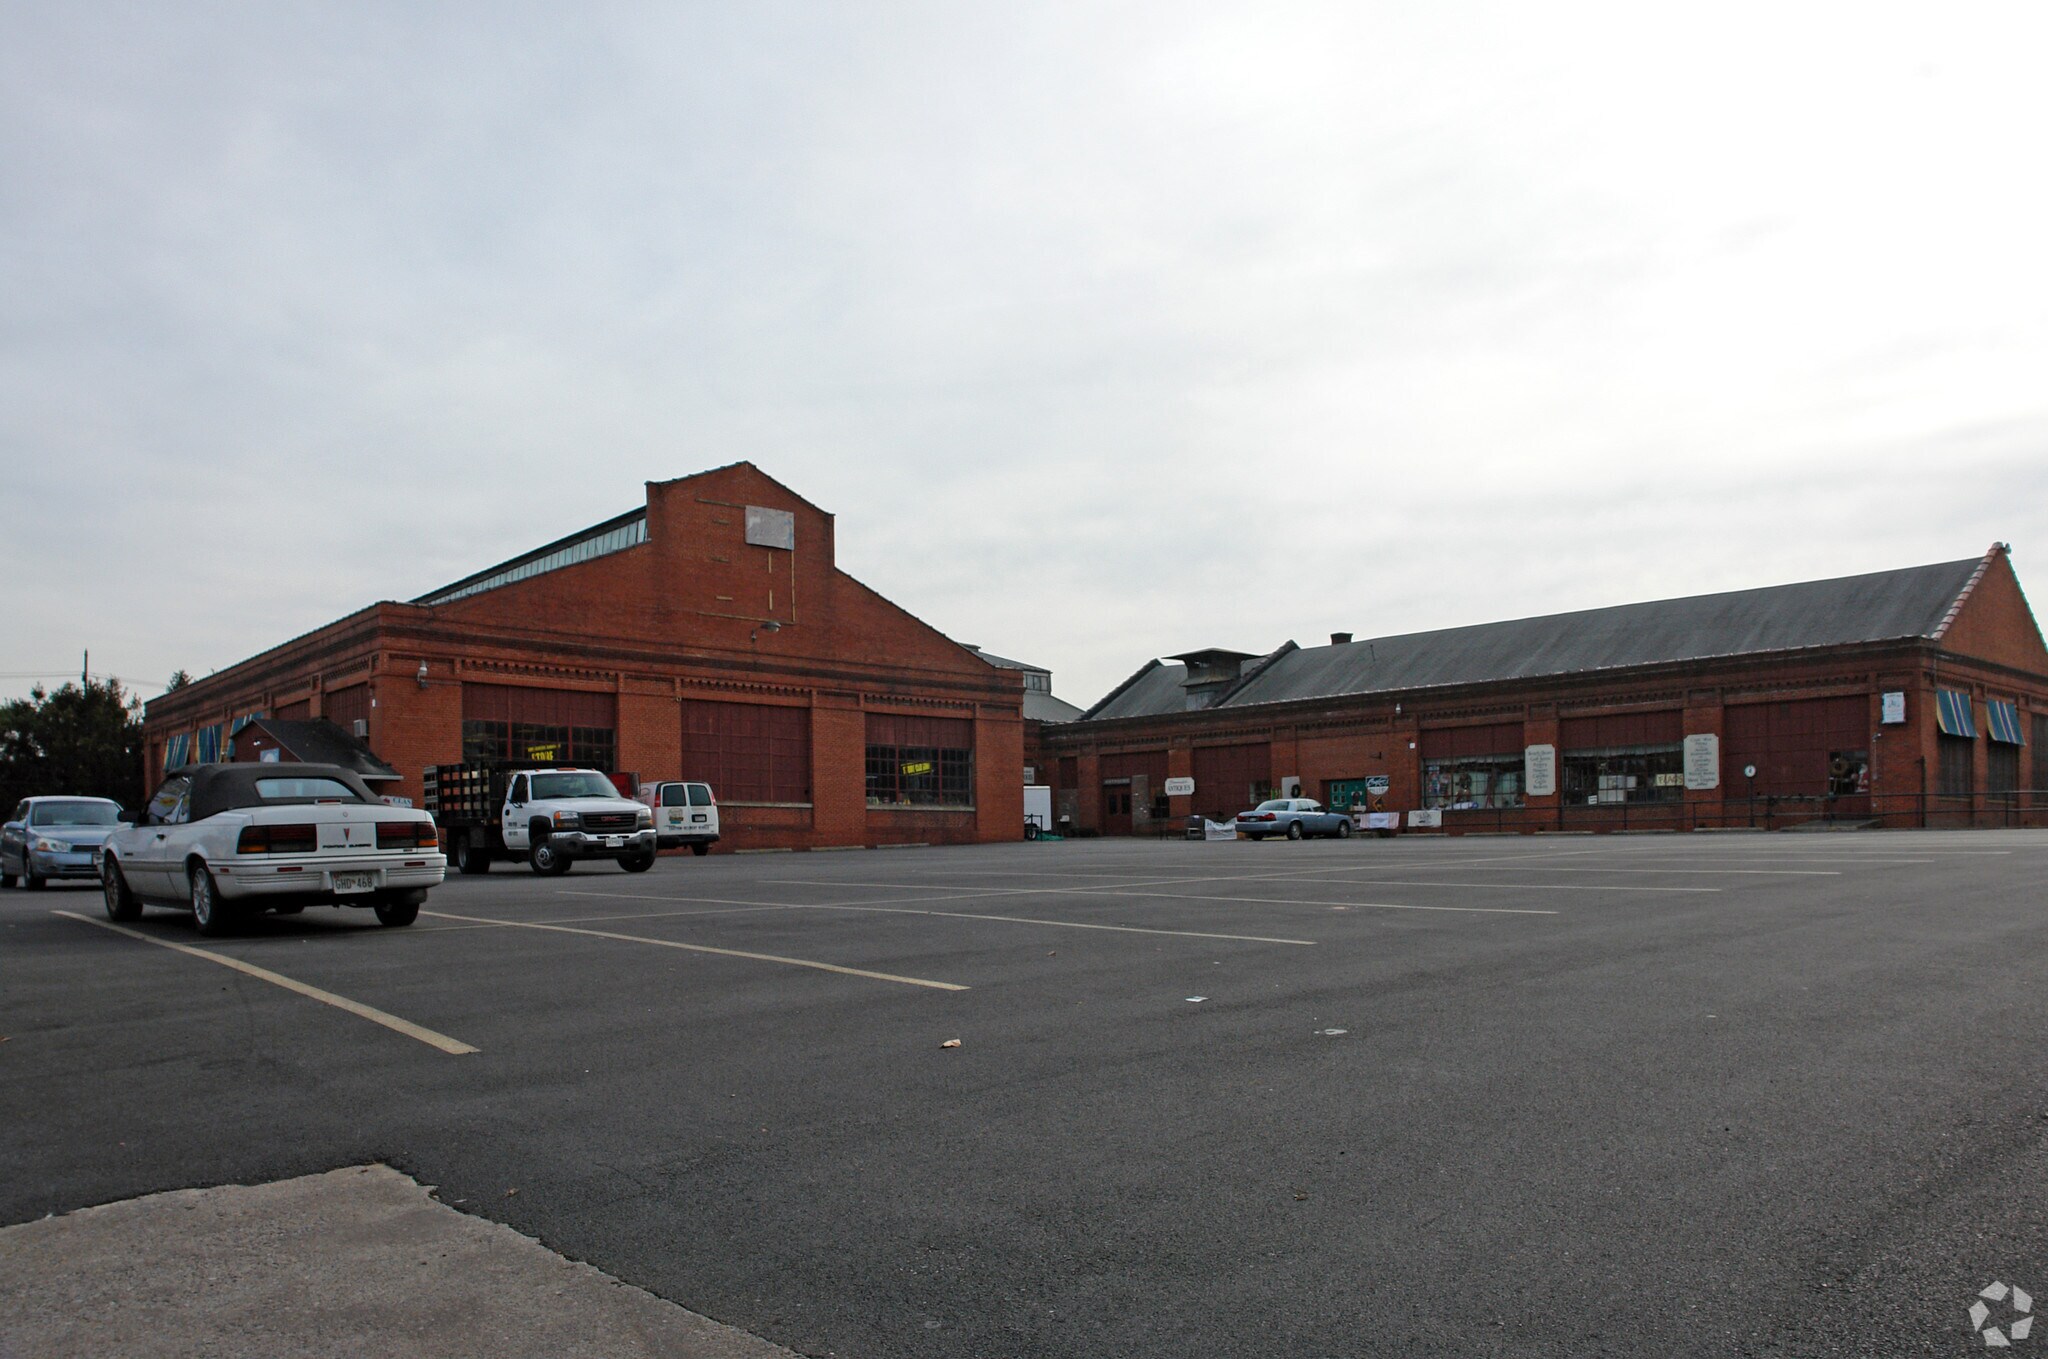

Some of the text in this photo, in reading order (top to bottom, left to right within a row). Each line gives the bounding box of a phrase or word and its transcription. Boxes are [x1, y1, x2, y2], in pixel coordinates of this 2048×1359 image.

[600, 815, 623, 823] GMC
[335, 876, 373, 889] GHD 468
